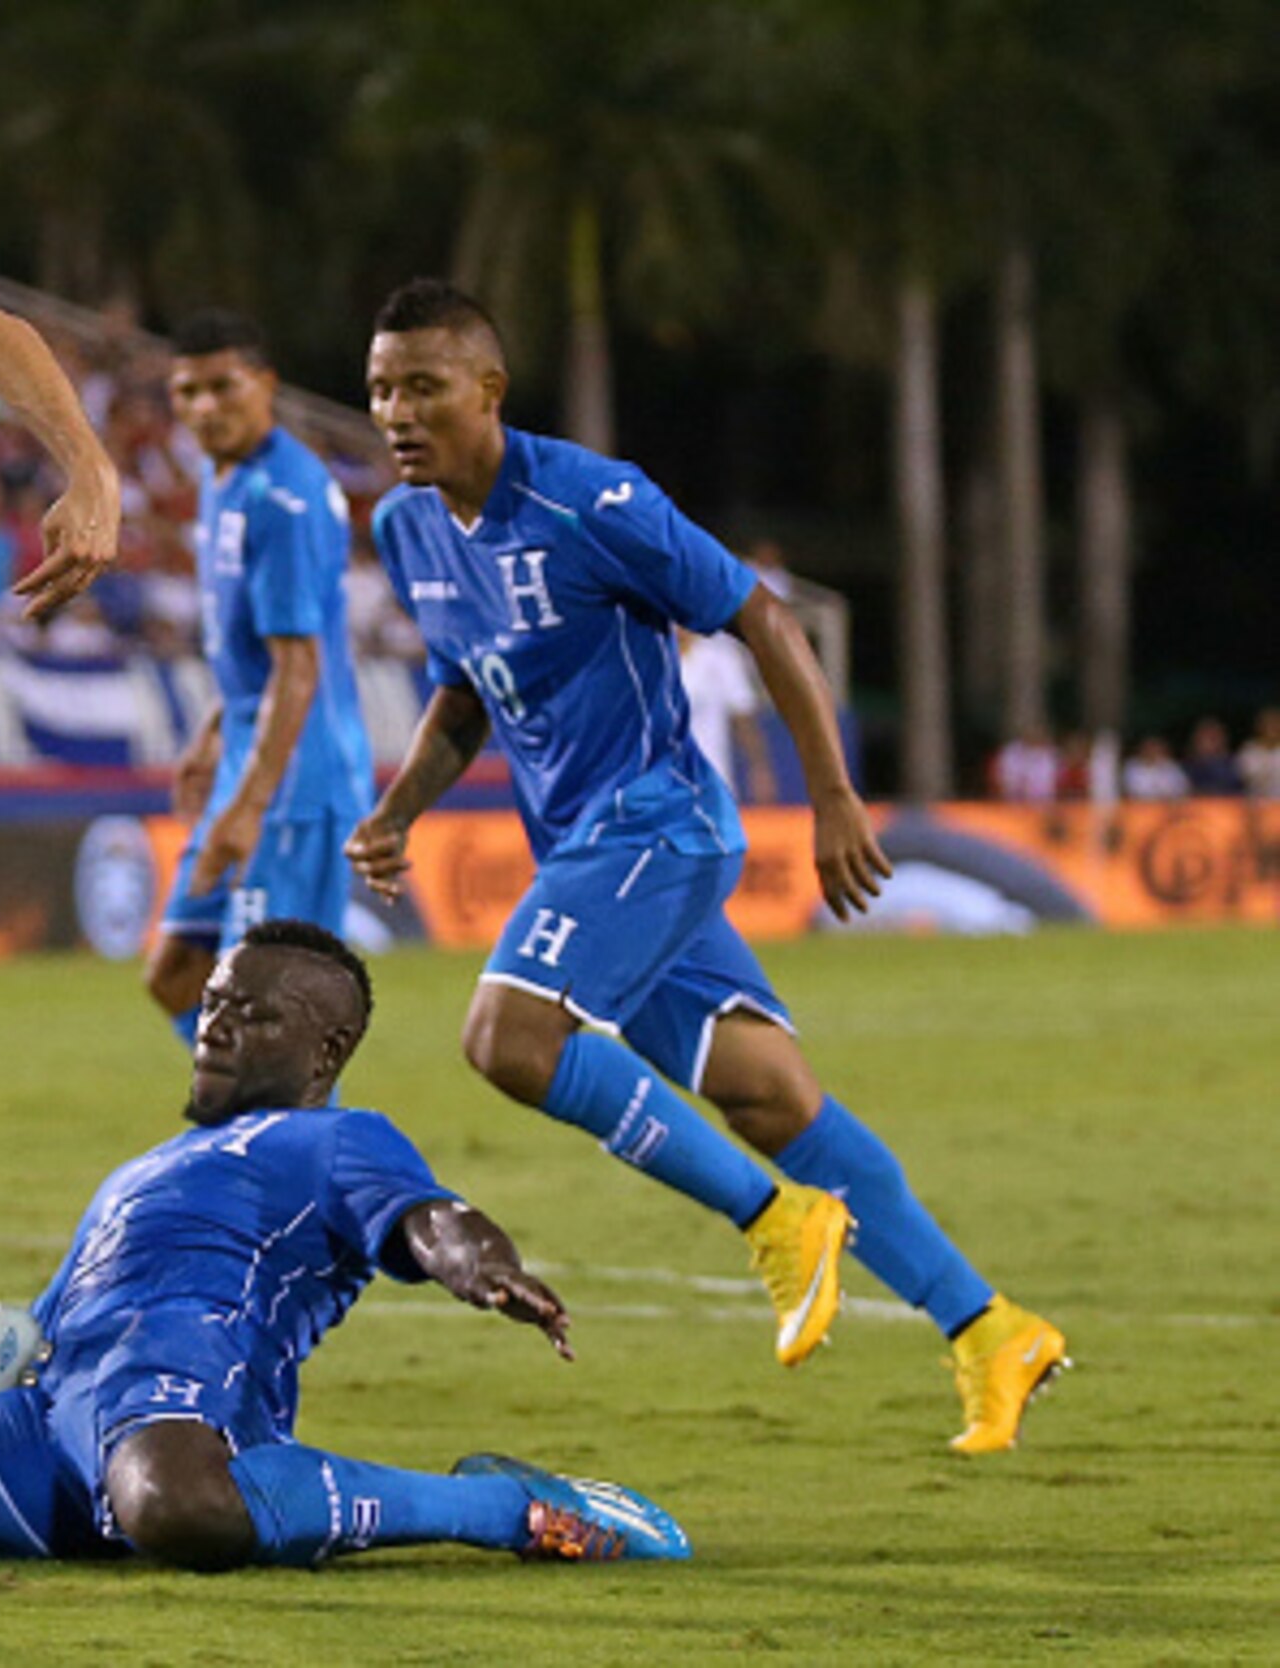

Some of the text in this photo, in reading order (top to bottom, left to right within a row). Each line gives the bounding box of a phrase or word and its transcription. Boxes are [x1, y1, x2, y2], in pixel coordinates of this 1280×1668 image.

[495, 549, 564, 632] H
[517, 908, 580, 968] H
[148, 1373, 205, 1408] H
